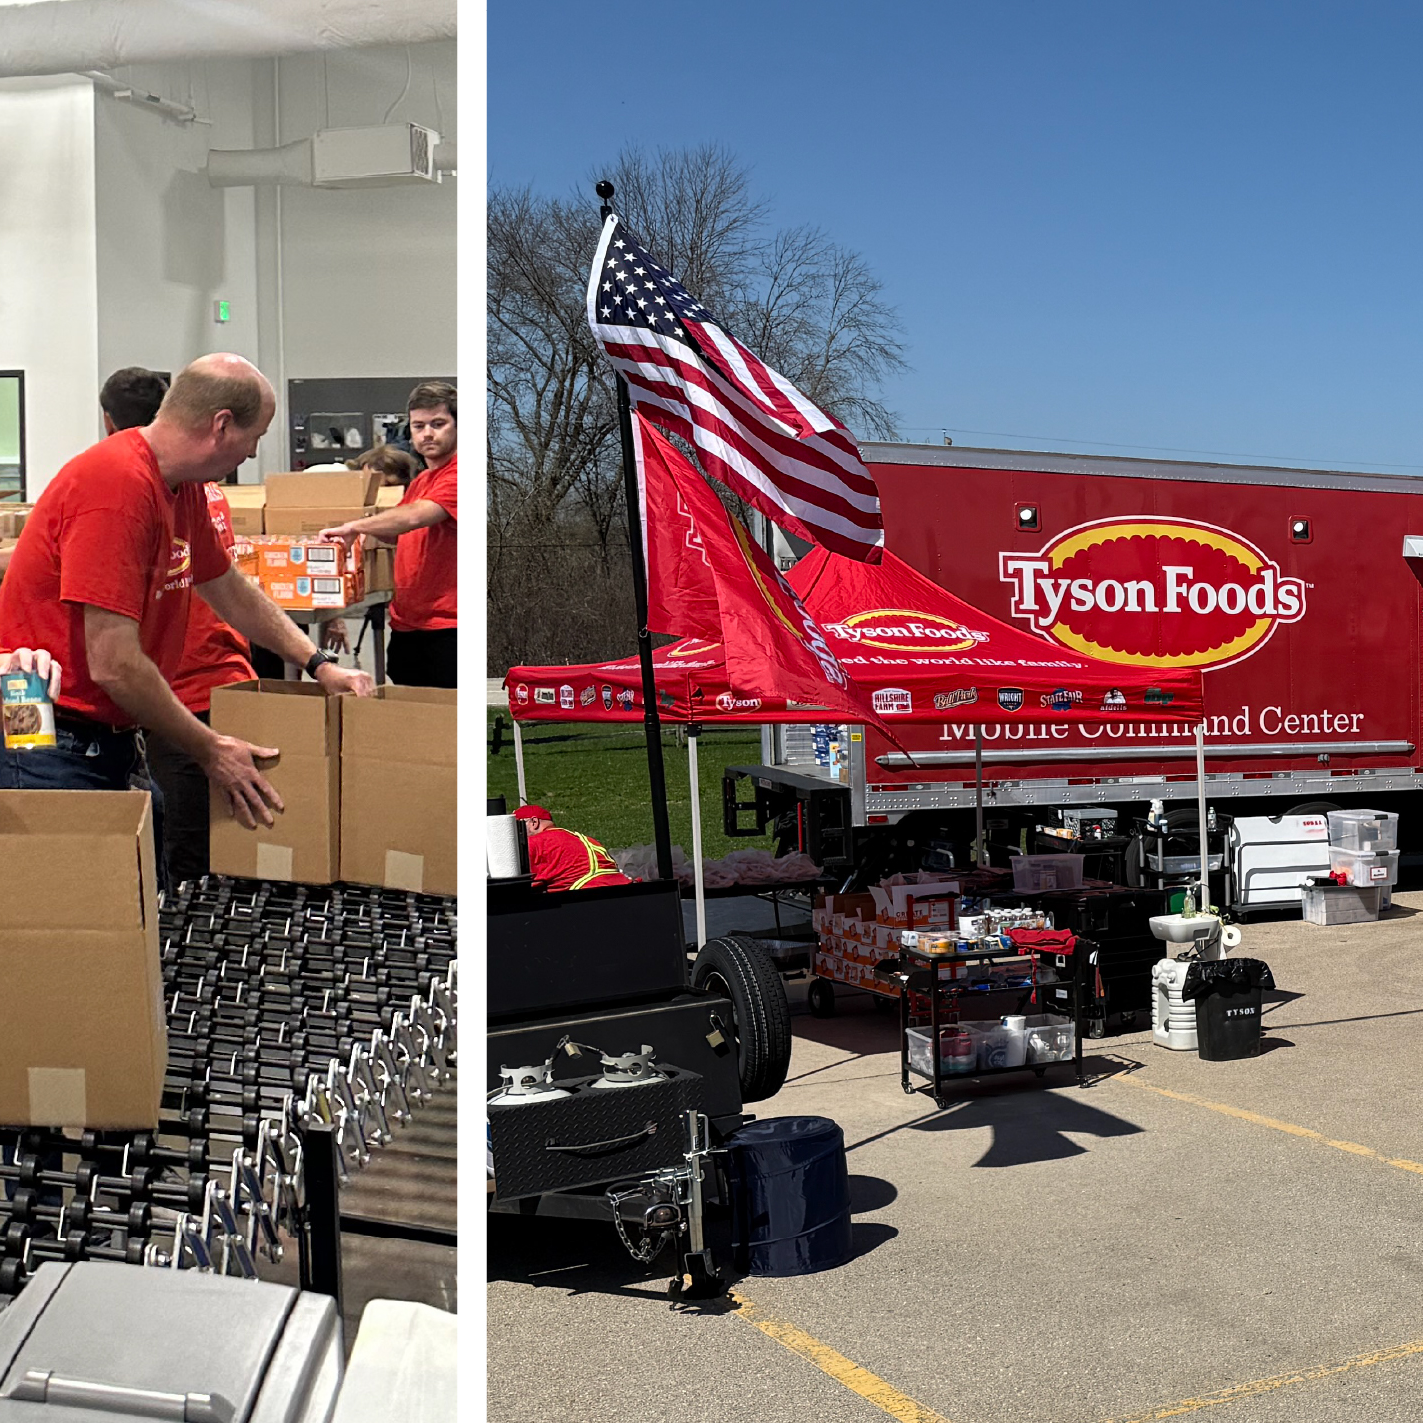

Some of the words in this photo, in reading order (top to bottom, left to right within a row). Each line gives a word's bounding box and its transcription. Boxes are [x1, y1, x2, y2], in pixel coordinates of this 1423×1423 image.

[1008, 560, 1161, 625] Tyson
[1162, 565, 1300, 616] Foods
[827, 624, 906, 640] Tyson
[906, 623, 987, 641] Foods
[721, 695, 758, 709] Tyson
[999, 692, 1022, 702] WRIGHT
[1259, 706, 1364, 735] Center
[1226, 1007, 1255, 1017] TYSON
